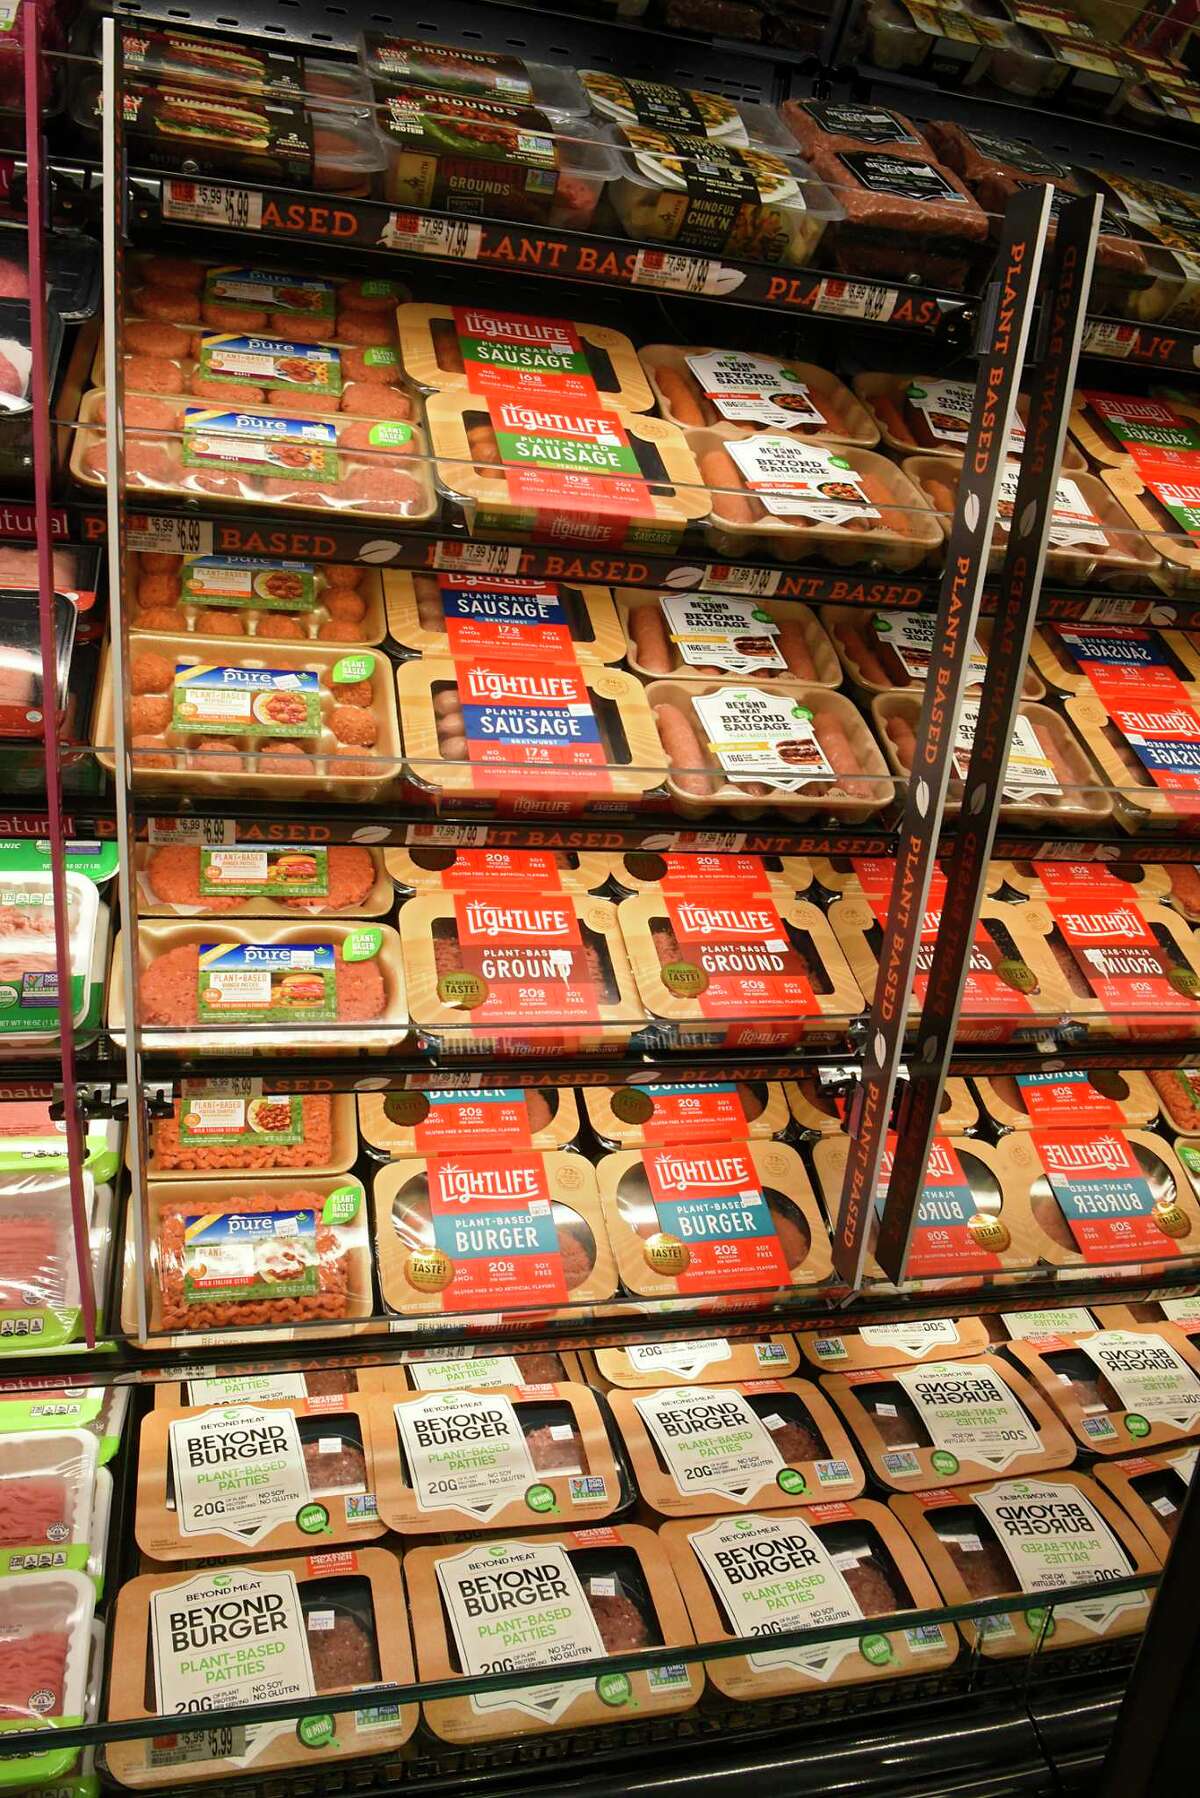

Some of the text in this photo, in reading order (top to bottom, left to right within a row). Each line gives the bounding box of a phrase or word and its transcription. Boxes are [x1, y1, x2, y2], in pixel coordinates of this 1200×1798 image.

[412, 45, 497, 64] GROUNDS
[424, 94, 518, 117] GROUNDS
[450, 176, 511, 197] GROUNDS
[692, 199, 736, 217] MINDFUL
[688, 212, 731, 231] CHIK'N
[247, 339, 295, 354] pure
[476, 346, 573, 369] SAUSAGE
[972, 241, 1026, 474] PLANT BASED
[712, 371, 775, 381] BEYOND
[715, 378, 781, 388] SAUSAGE
[235, 416, 288, 432] pure
[520, 435, 609, 452] PLANT-BASED
[759, 447, 803, 456] BEYOND
[515, 442, 622, 467] SAUSAGE
[755, 458, 823, 468] BEYOND
[758, 465, 830, 475] SAUSAGE
[220, 528, 337, 558] BASED
[632, 531, 673, 544] SAUSAGE
[546, 555, 648, 583] BASED
[461, 592, 538, 604] PLANT-BASED
[830, 580, 923, 607] BASED
[457, 599, 550, 618] SAUSAGE
[690, 601, 729, 610] BEYOND
[684, 612, 745, 622] BEYOND
[686, 619, 751, 629] SAUSAGE
[924, 555, 971, 764] PLANT BASED
[223, 669, 272, 686] pure
[485, 707, 570, 718] PLANT-BASED
[725, 701, 767, 709] BEYOND
[480, 716, 582, 737] SAUSAGE
[720, 714, 786, 724] BEYOND
[723, 722, 792, 732] SAUSAGE
[524, 747, 549, 758] 17g
[524, 831, 624, 849] BASED
[799, 837, 886, 855] BASED
[880, 834, 922, 1021] PLANT BASED
[244, 949, 291, 964] pure
[701, 954, 784, 972] GROUND
[668, 973, 700, 982] TASTE!
[445, 985, 480, 994] TASTE!
[518, 988, 546, 997] 20g
[844, 1081, 881, 1248] PLANT BASED
[331, 1195, 357, 1204] PLANT-
[331, 1203, 354, 1212] BASED
[676, 1200, 748, 1214] PLANT-BASED
[227, 1217, 274, 1234] pure
[455, 1214, 534, 1229] PLANT-BASED
[678, 1211, 758, 1237] BURGER
[455, 1226, 540, 1252] BURGER
[650, 1248, 683, 1260] TASTE!
[713, 1244, 738, 1256] 20g
[412, 1262, 448, 1274] TASTE!
[488, 1261, 516, 1273] 20g
[637, 1346, 663, 1358] 20G
[427, 1358, 500, 1376] PLANT-BASED
[446, 1367, 488, 1381] PATTIES
[224, 1379, 270, 1394] PATTIES
[423, 1405, 461, 1415] BEYOND
[661, 1397, 695, 1407] BEYOND
[413, 1410, 504, 1434] BEYOND
[655, 1402, 739, 1426] BEYOND
[200, 1415, 265, 1431] BEYOND MEAT
[663, 1412, 749, 1438] BURGER
[186, 1425, 285, 1453] BEYOND
[416, 1422, 511, 1448] BURGER
[677, 1431, 754, 1453] PLANT-BASED
[188, 1437, 289, 1468] BURGER
[427, 1441, 511, 1464] PLANT-BASED
[698, 1442, 744, 1458] PATTIES
[196, 1459, 288, 1485] PLANT-BASED
[448, 1455, 497, 1472] PATTIES
[684, 1464, 713, 1480] 20G
[751, 1459, 775, 1469] GLUTEN
[218, 1473, 271, 1492] PATTIES
[428, 1479, 459, 1495] 20G
[501, 1473, 526, 1484] GLUTEN
[272, 1493, 300, 1503] GLUTEN
[193, 1500, 226, 1518] 20G
[719, 1525, 781, 1543] BEYOND MEAT
[714, 1535, 808, 1568] BEYOND
[468, 1552, 536, 1571] BEYOND MEAT
[723, 1550, 821, 1585] BURGER
[458, 1564, 561, 1598] BEYOND
[741, 1573, 826, 1602] PLANT-BASED
[186, 1580, 262, 1602] BEYOND MEAT
[463, 1580, 570, 1617] BURGER
[766, 1591, 816, 1611] PATTIES
[170, 1593, 284, 1632] BEYOND
[821, 1606, 835, 1615] SOY
[825, 1610, 851, 1623] GLUTEN
[477, 1607, 573, 1638] PLANT-BASED
[750, 1621, 782, 1637] 20G
[172, 1610, 289, 1653] BURGER
[502, 1624, 557, 1647] PATTIES
[550, 1646, 592, 1663] NO GLUTEN
[561, 1641, 576, 1652] SOY
[179, 1641, 286, 1675] PLANT-BASED
[479, 1658, 514, 1673] 20G
[204, 1660, 266, 1685] PATTIES
[252, 1684, 300, 1702] NO GLUTEN
[264, 1680, 284, 1691] SOY
[175, 1696, 213, 1715] 20G
